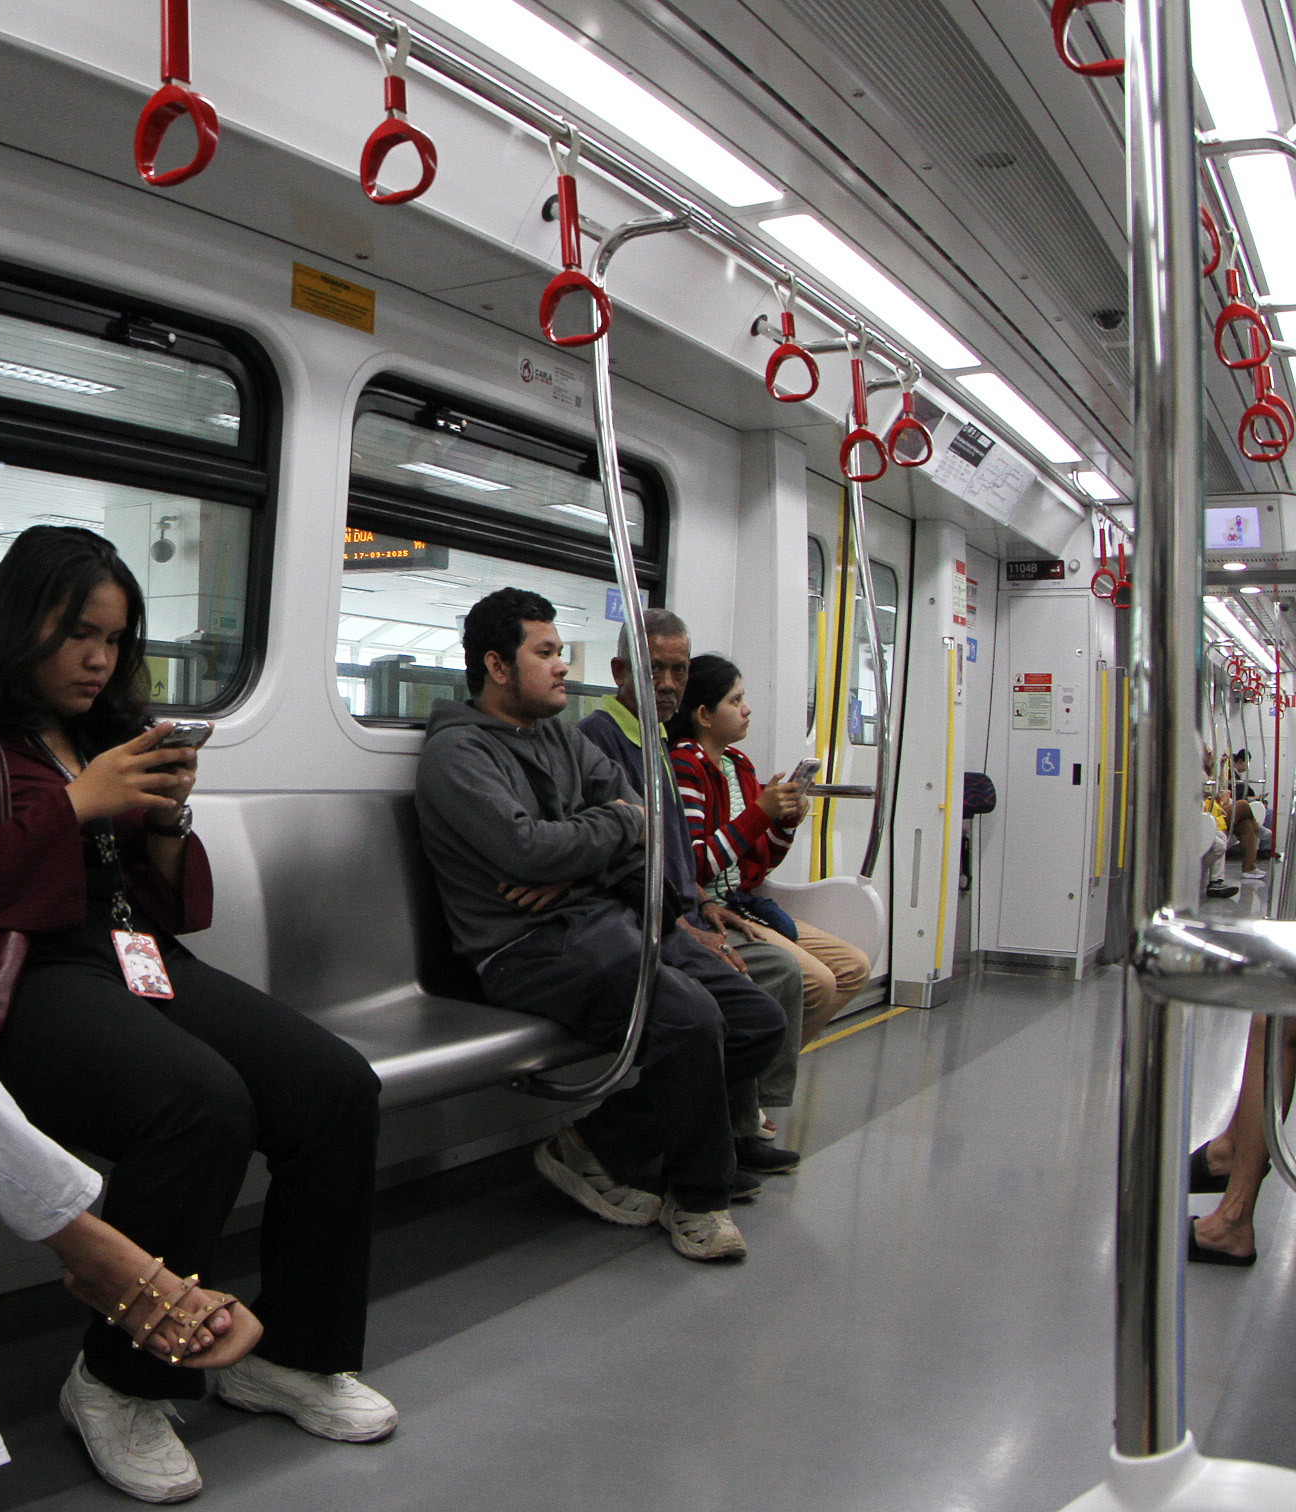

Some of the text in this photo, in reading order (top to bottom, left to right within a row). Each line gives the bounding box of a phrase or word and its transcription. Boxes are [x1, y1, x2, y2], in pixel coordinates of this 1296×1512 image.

[353, 532, 374, 542] DUA
[353, 550, 409, 559] 17-09-2025
[1008, 563, 1038, 574] 1104B
